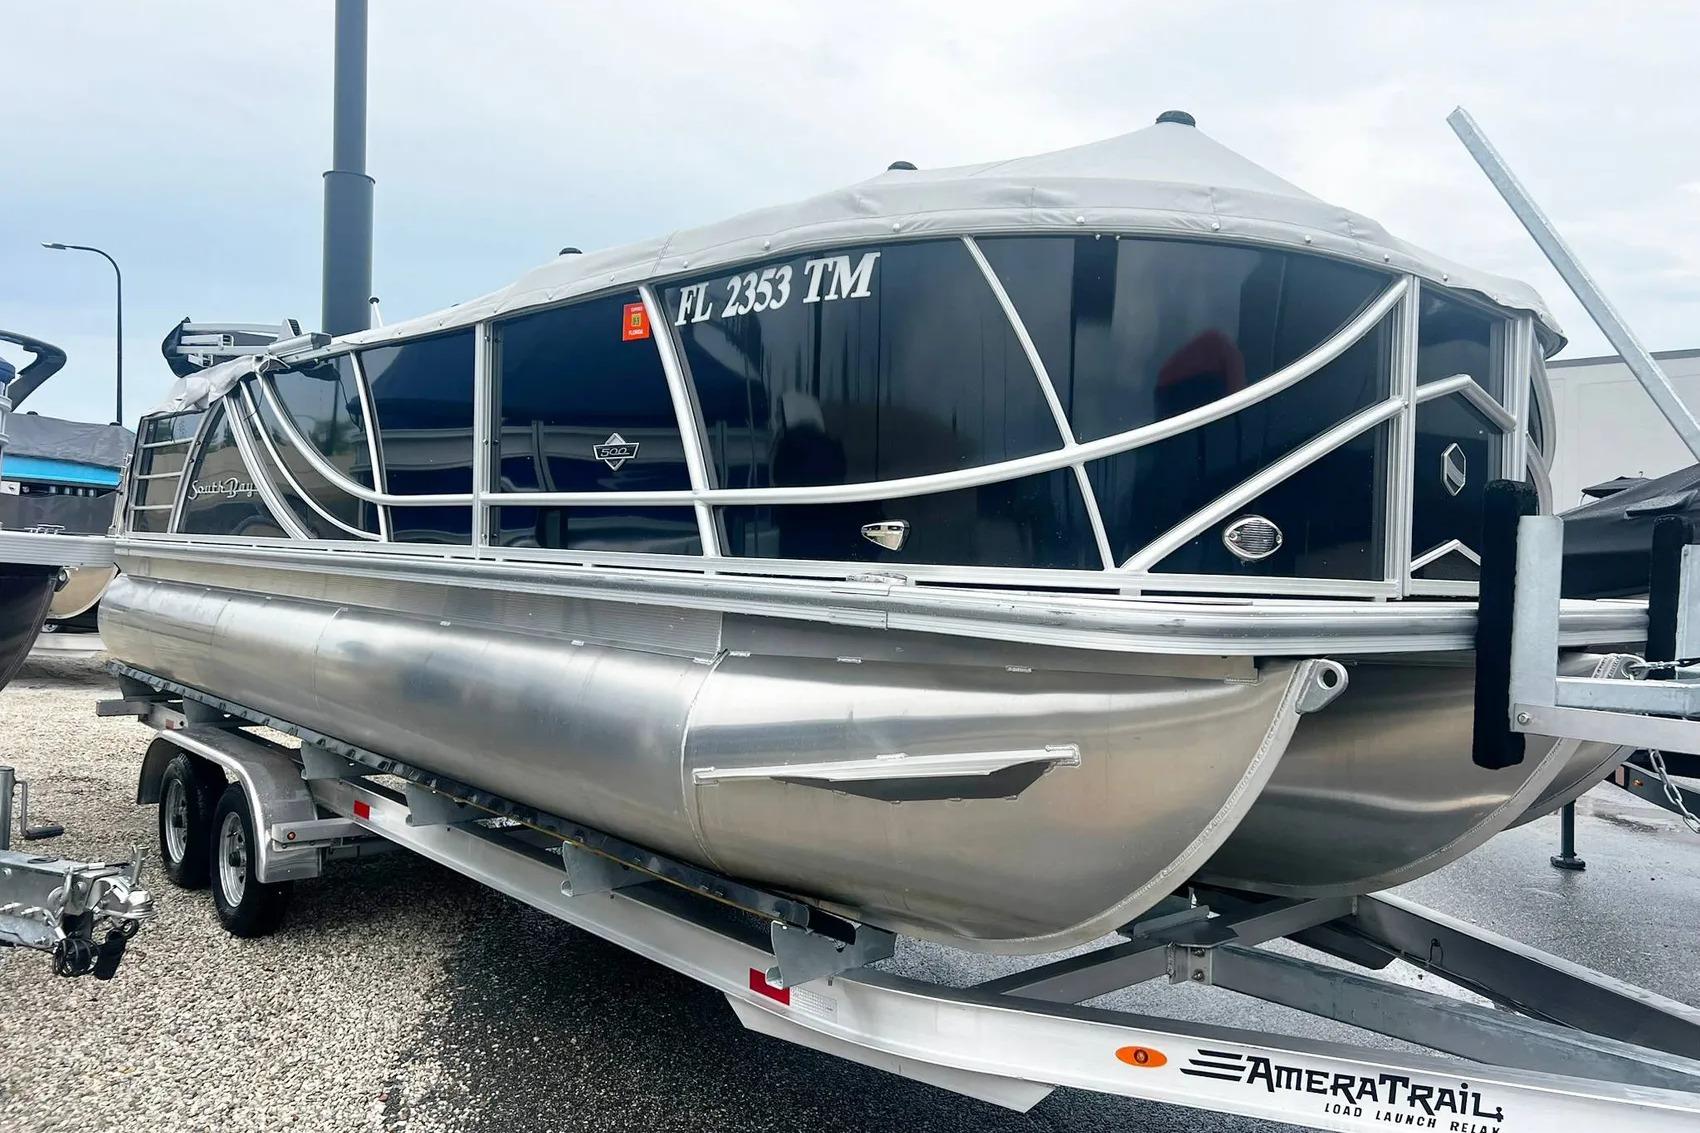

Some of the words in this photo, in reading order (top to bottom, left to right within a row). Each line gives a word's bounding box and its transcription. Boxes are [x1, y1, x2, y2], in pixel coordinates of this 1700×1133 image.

[674, 281, 712, 327] FL
[721, 265, 793, 319] 2353
[803, 251, 881, 304] TM
[1324, 1103, 1363, 1118] LOAD
[1375, 1110, 1437, 1129] LAUNCH
